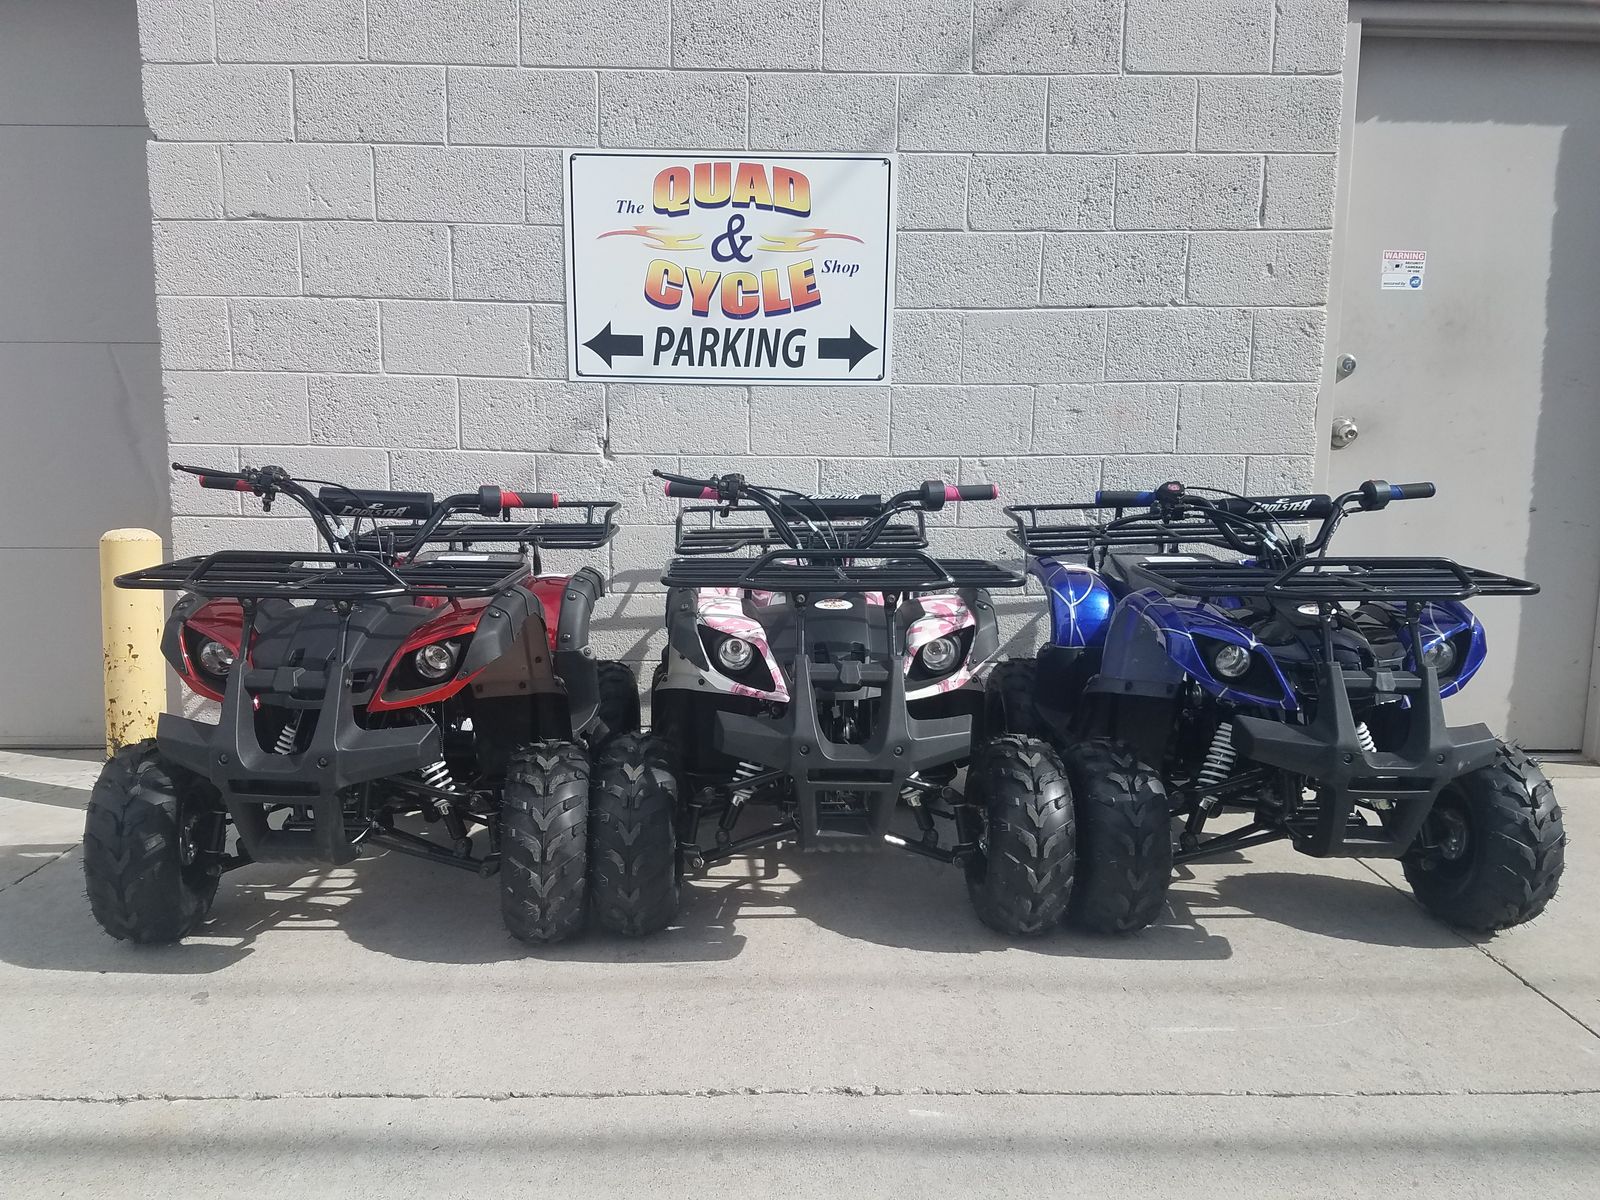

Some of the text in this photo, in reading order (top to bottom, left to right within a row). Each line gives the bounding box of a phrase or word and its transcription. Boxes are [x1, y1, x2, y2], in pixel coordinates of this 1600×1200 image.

[616, 162, 811, 218] The QUAD
[711, 213, 753, 263] &
[1384, 251, 1425, 260] WARNING
[644, 257, 860, 320] CYCLE Shop
[653, 326, 807, 368] PARKING
